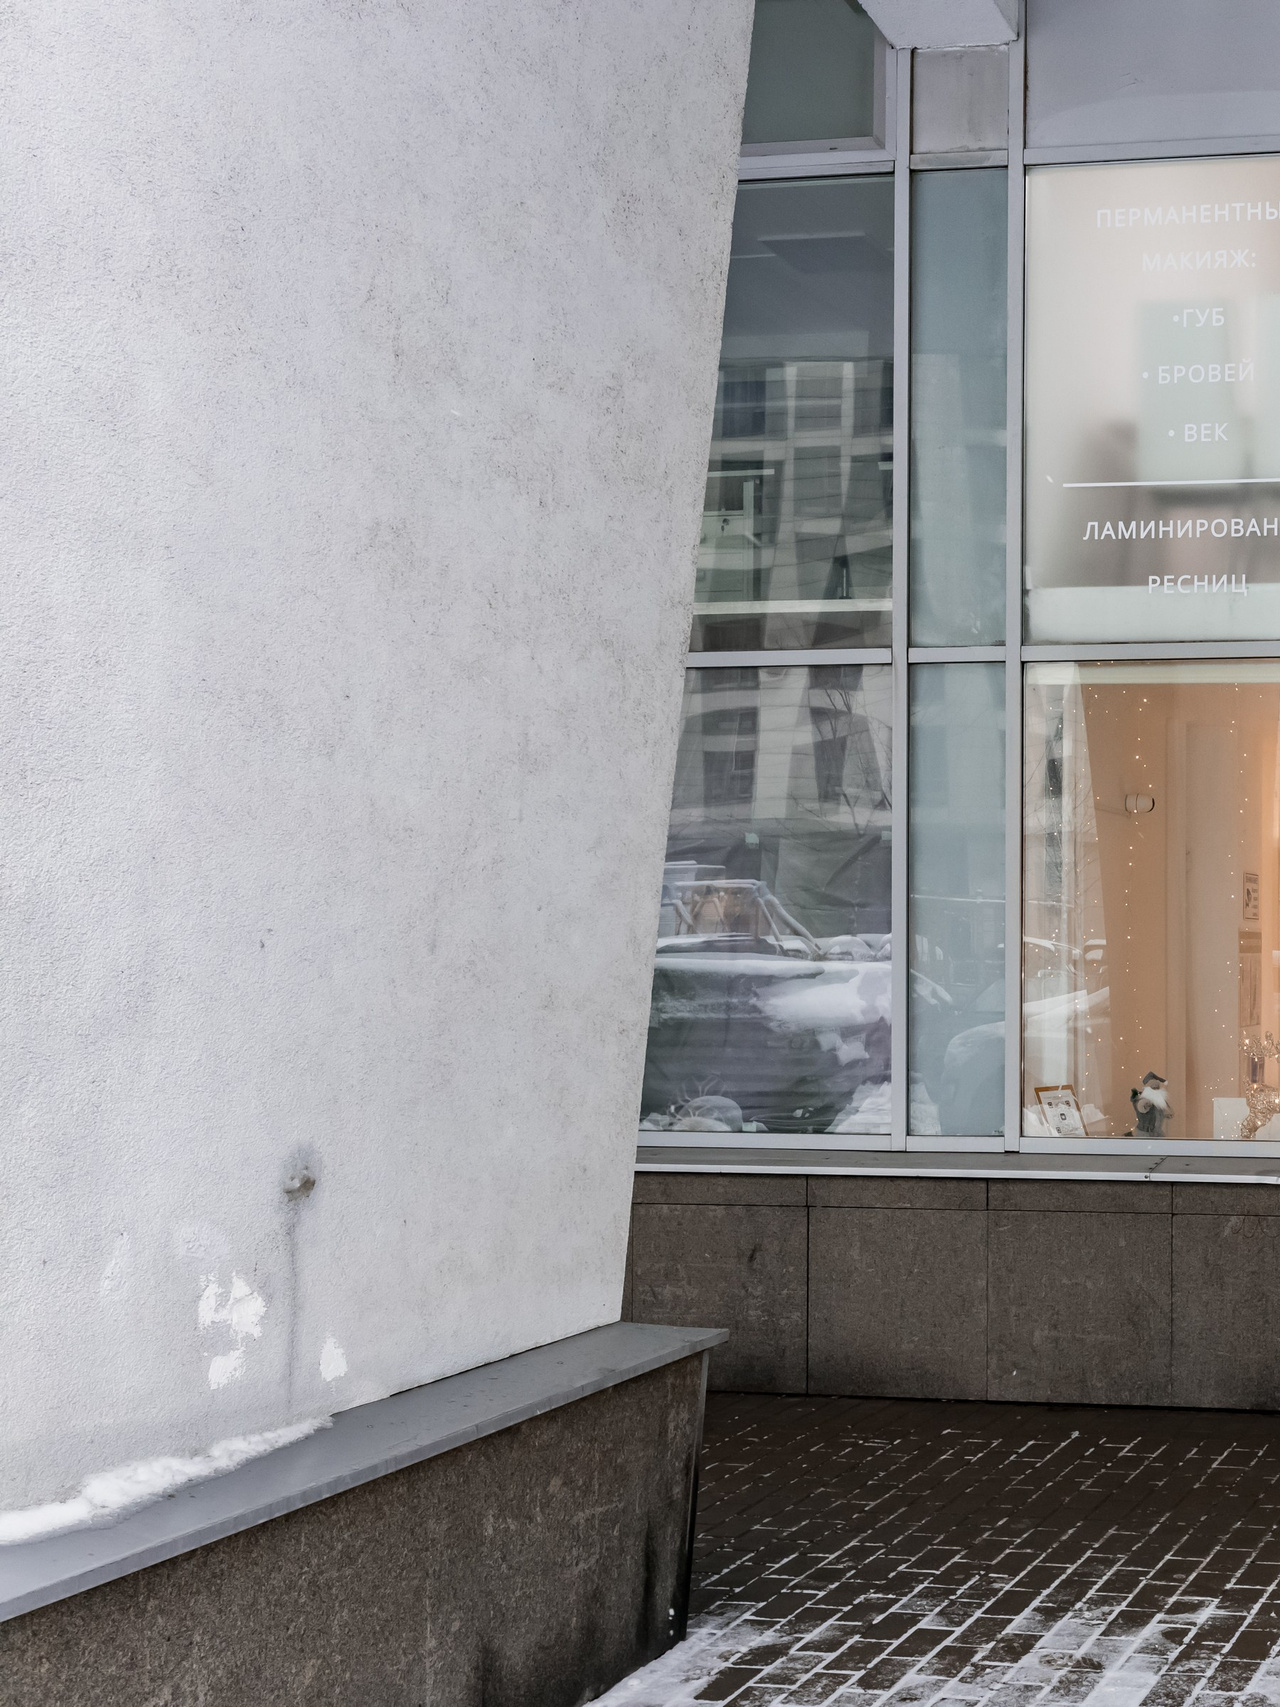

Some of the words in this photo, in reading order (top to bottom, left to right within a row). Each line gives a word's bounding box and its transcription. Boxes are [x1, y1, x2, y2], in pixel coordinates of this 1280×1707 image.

[1141, 248, 1257, 272] МАКИЯЖ:
[1157, 358, 1255, 385] БРОВЕЙ
[1184, 422, 1229, 443] ВЕК
[1148, 573, 1249, 597] РЕСНИЦ
